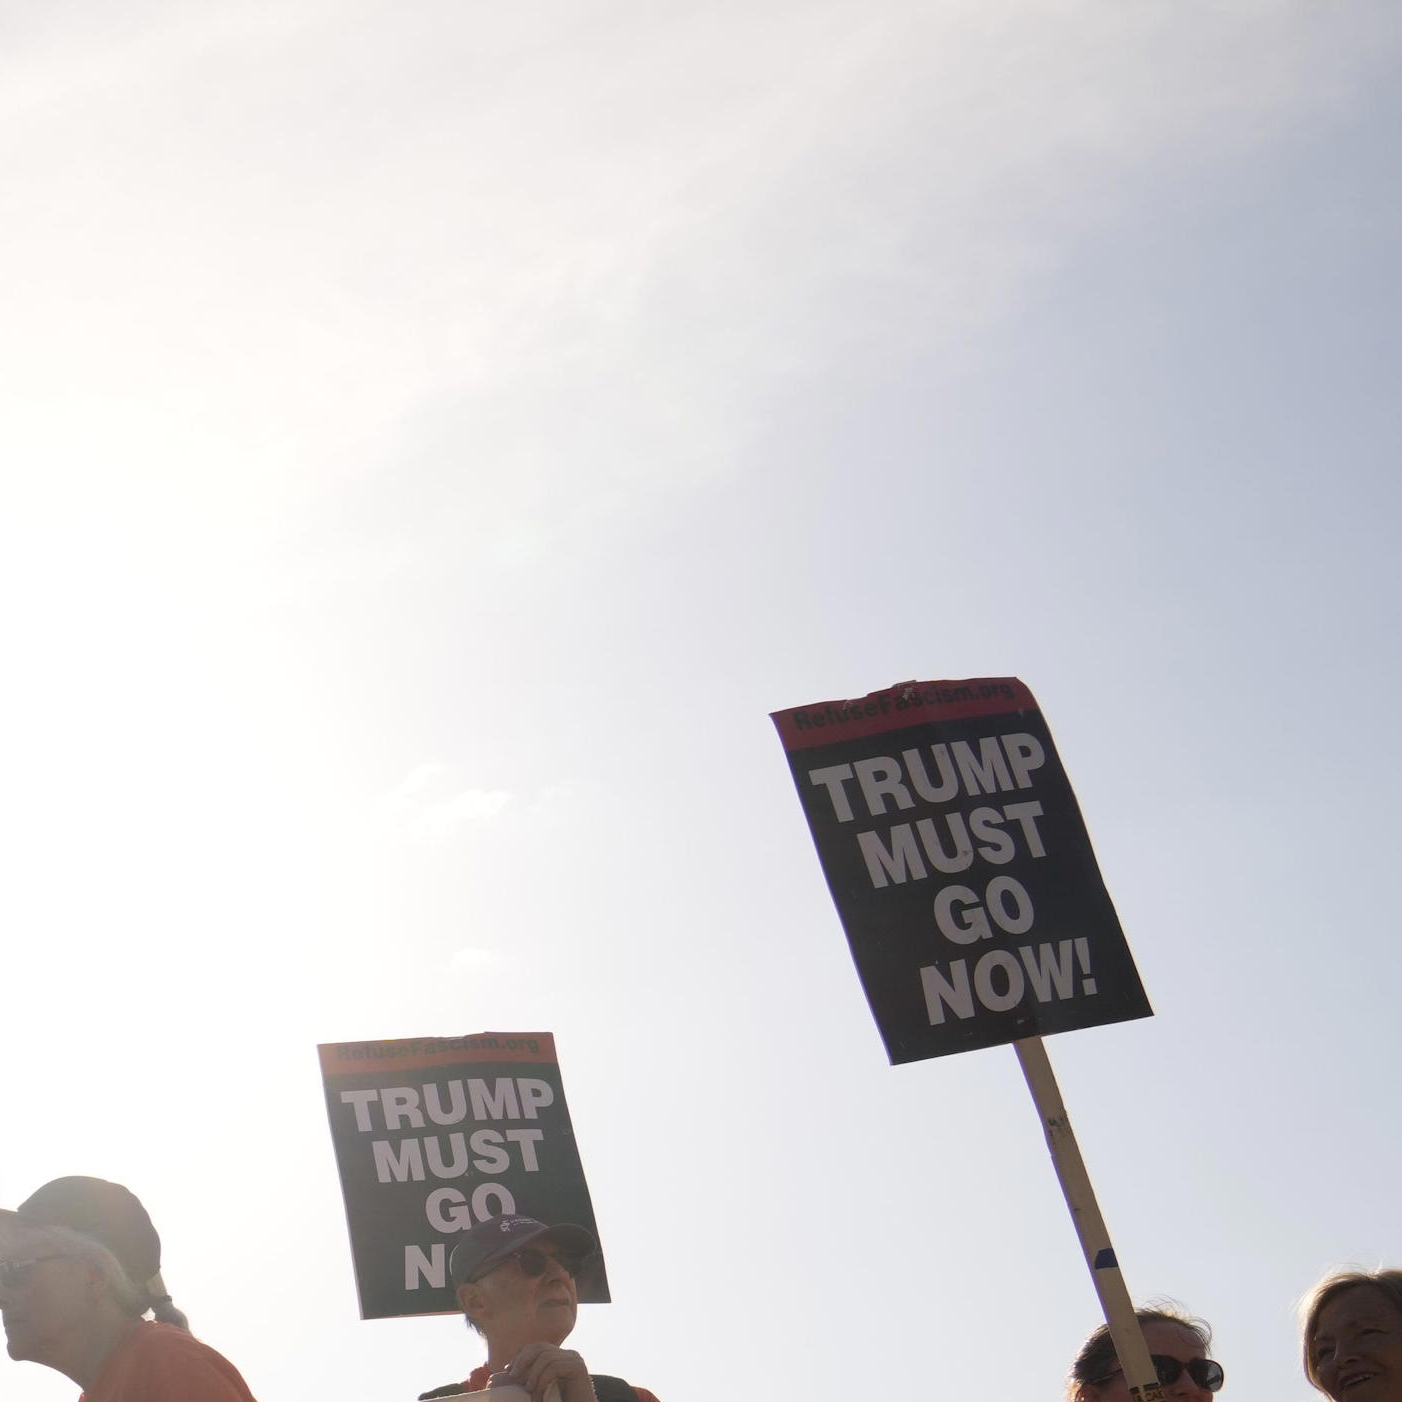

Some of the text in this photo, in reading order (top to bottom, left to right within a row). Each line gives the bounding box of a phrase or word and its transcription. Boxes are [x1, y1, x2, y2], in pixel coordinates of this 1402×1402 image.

[808, 732, 1046, 824] TRUMP
[856, 800, 1048, 889] MUST
[933, 875, 1035, 946] GO
[919, 936, 1098, 1026] NOW!
[339, 1077, 555, 1133] TRUMP
[371, 1128, 545, 1184] MUST
[424, 1182, 516, 1234] GO
